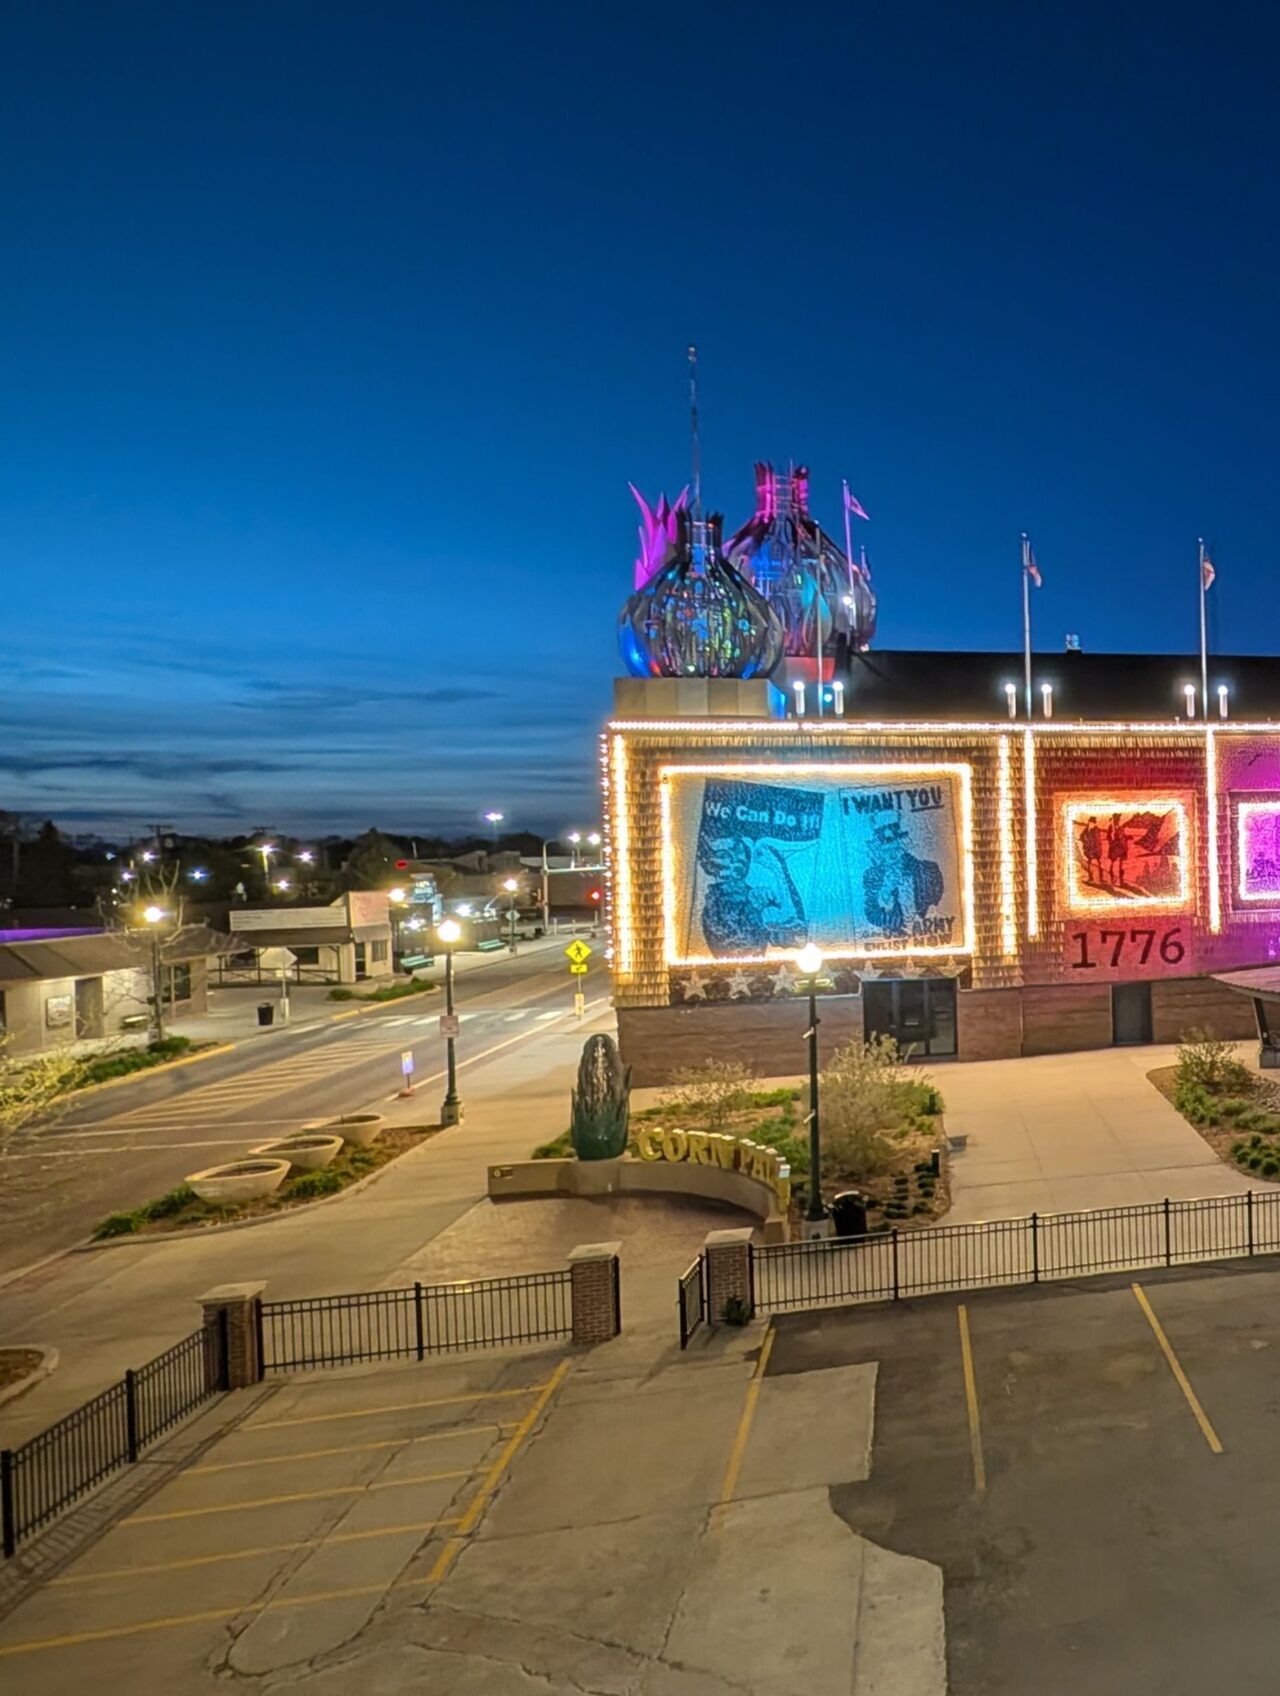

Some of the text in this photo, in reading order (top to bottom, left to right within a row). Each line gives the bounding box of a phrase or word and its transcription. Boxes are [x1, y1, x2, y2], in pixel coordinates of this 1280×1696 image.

[705, 801, 730, 819] We
[736, 805, 769, 823] Can
[774, 810, 796, 827] Do
[843, 786, 942, 816] I WANT YOU
[912, 916, 955, 937] ARMY
[864, 933, 952, 951] ENLIST NOW
[1072, 927, 1185, 968] 1776
[638, 1127, 736, 1169] CORN
